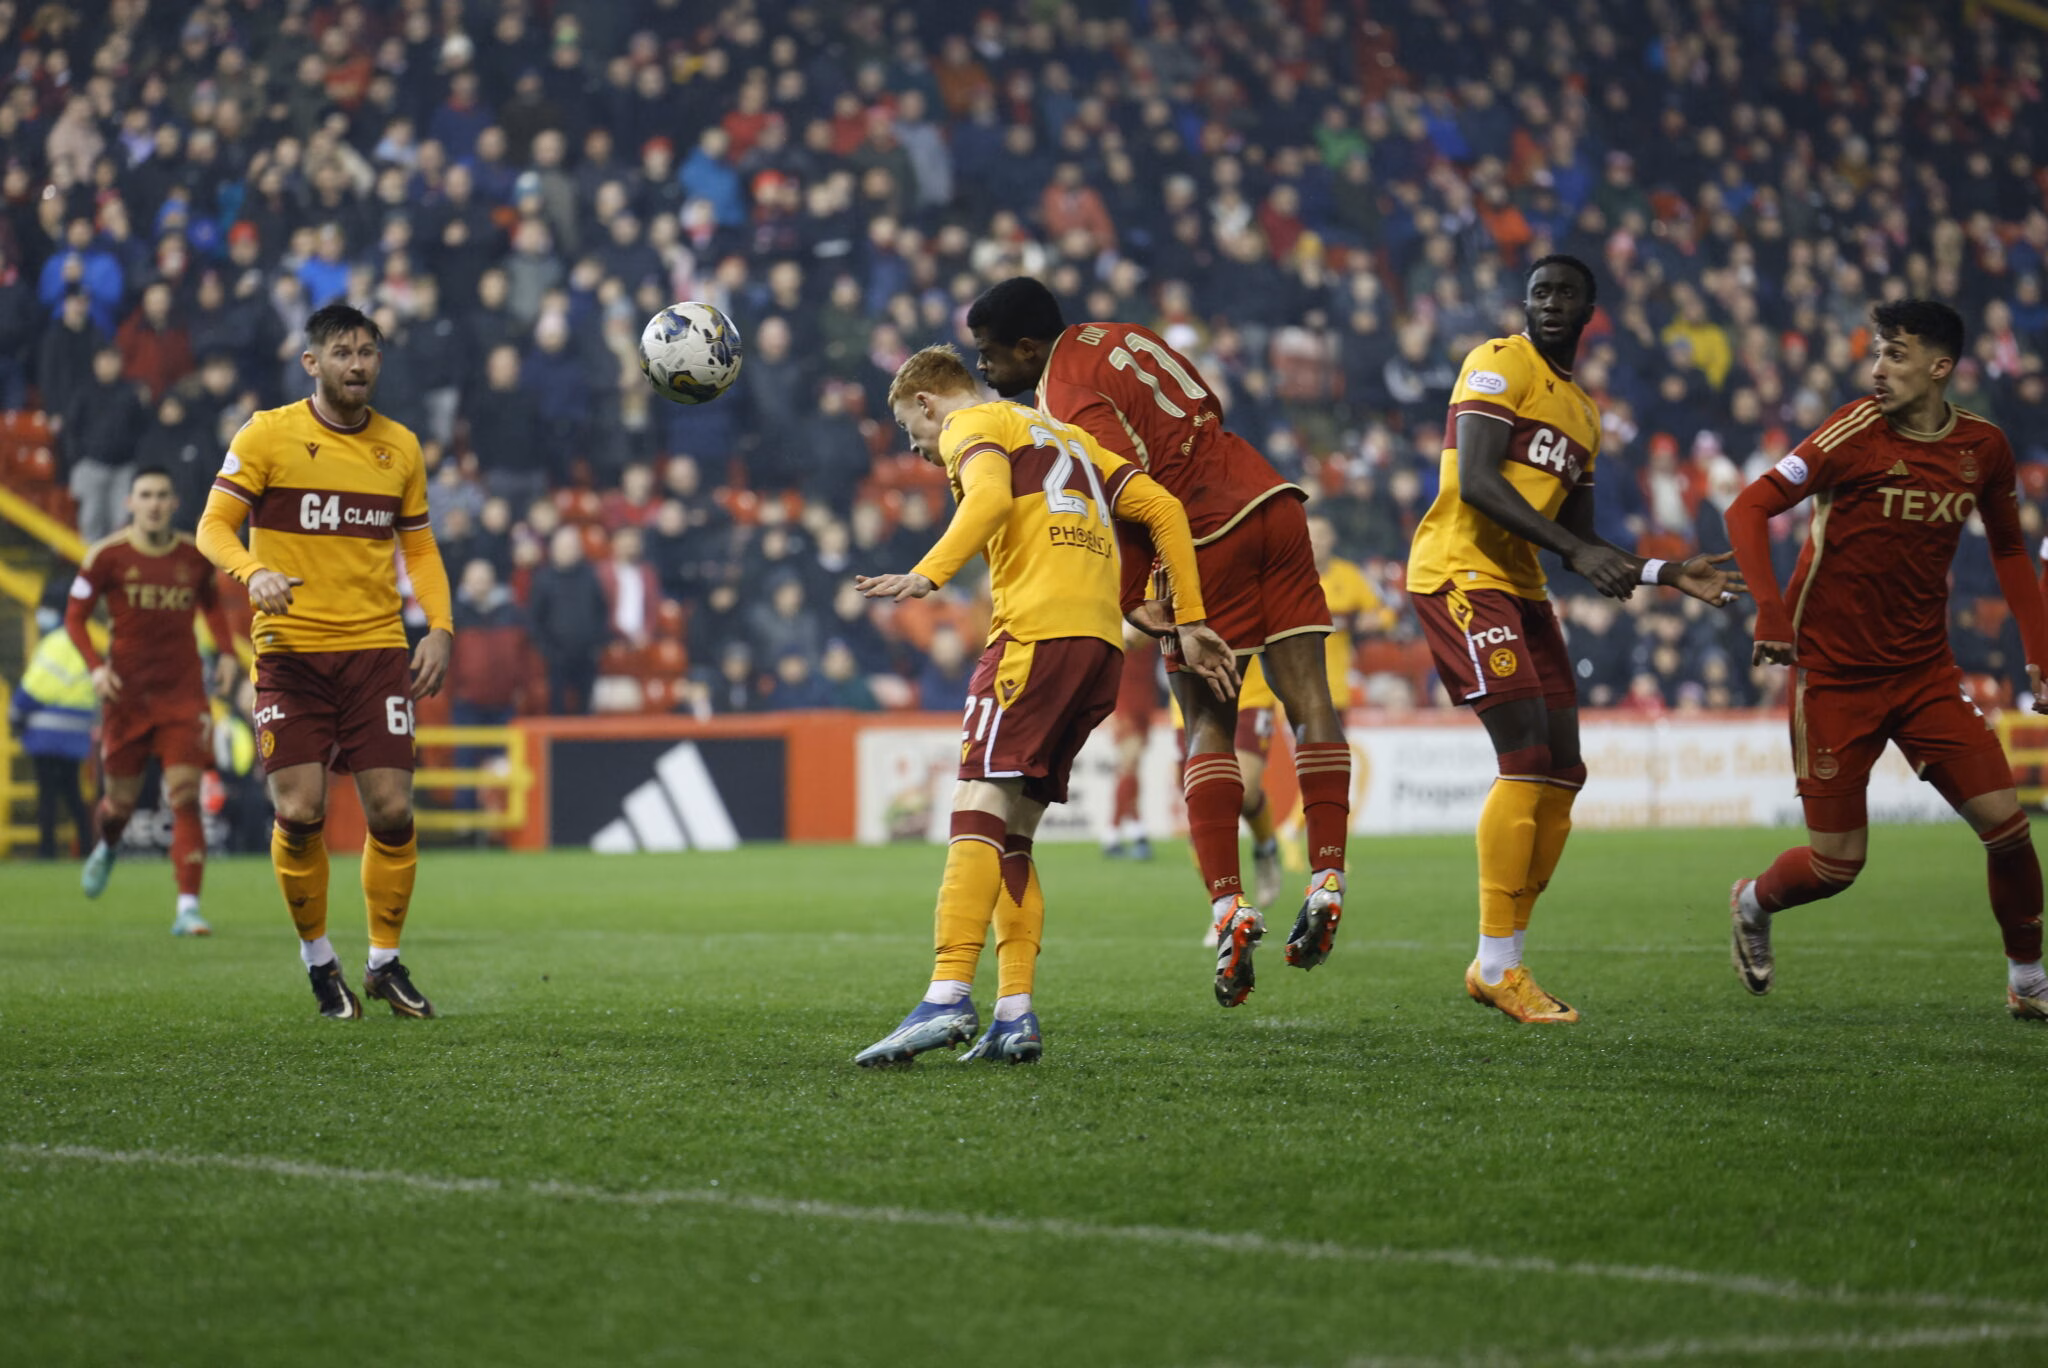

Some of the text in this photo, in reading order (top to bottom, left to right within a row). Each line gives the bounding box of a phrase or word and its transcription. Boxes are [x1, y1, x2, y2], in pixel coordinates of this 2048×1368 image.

[1109, 332, 1208, 418] 11
[1528, 428, 1568, 472] G4
[1029, 424, 1109, 527] 21
[300, 493, 341, 530] G4
[1877, 487, 1976, 523] TEXO
[1472, 626, 1518, 649] TCL
[255, 704, 286, 727] TCL
[961, 695, 993, 741] 21
[1319, 846, 1342, 857] AFC
[1214, 876, 1239, 889] AFC
